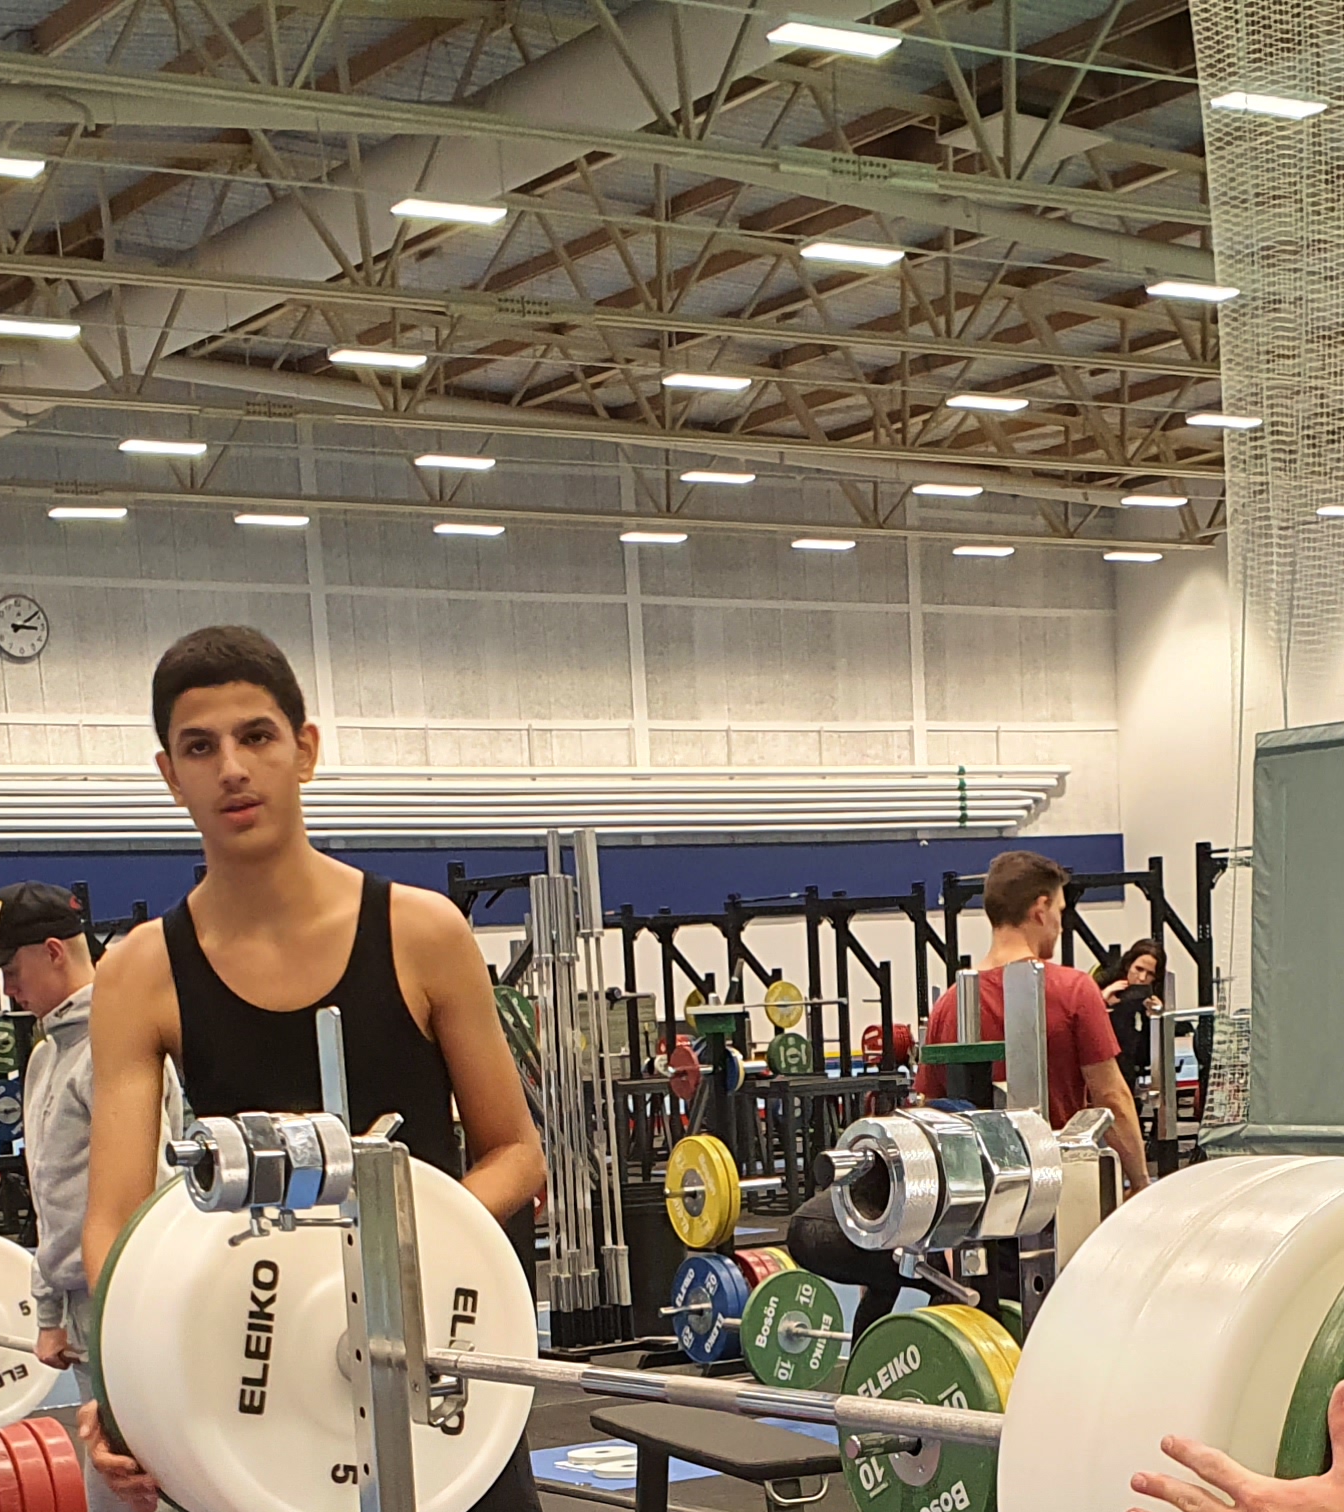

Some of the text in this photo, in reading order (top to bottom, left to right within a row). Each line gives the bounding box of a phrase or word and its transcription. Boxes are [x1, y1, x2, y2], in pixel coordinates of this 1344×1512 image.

[18, 1300, 32, 1316] 5
[798, 1283, 814, 1308] 10
[756, 1296, 780, 1349] Bosön
[239, 1259, 279, 1415] ELEIKO
[775, 1359, 793, 1381] 10
[331, 1463, 358, 1485] 5
[859, 1456, 885, 1491] 10
